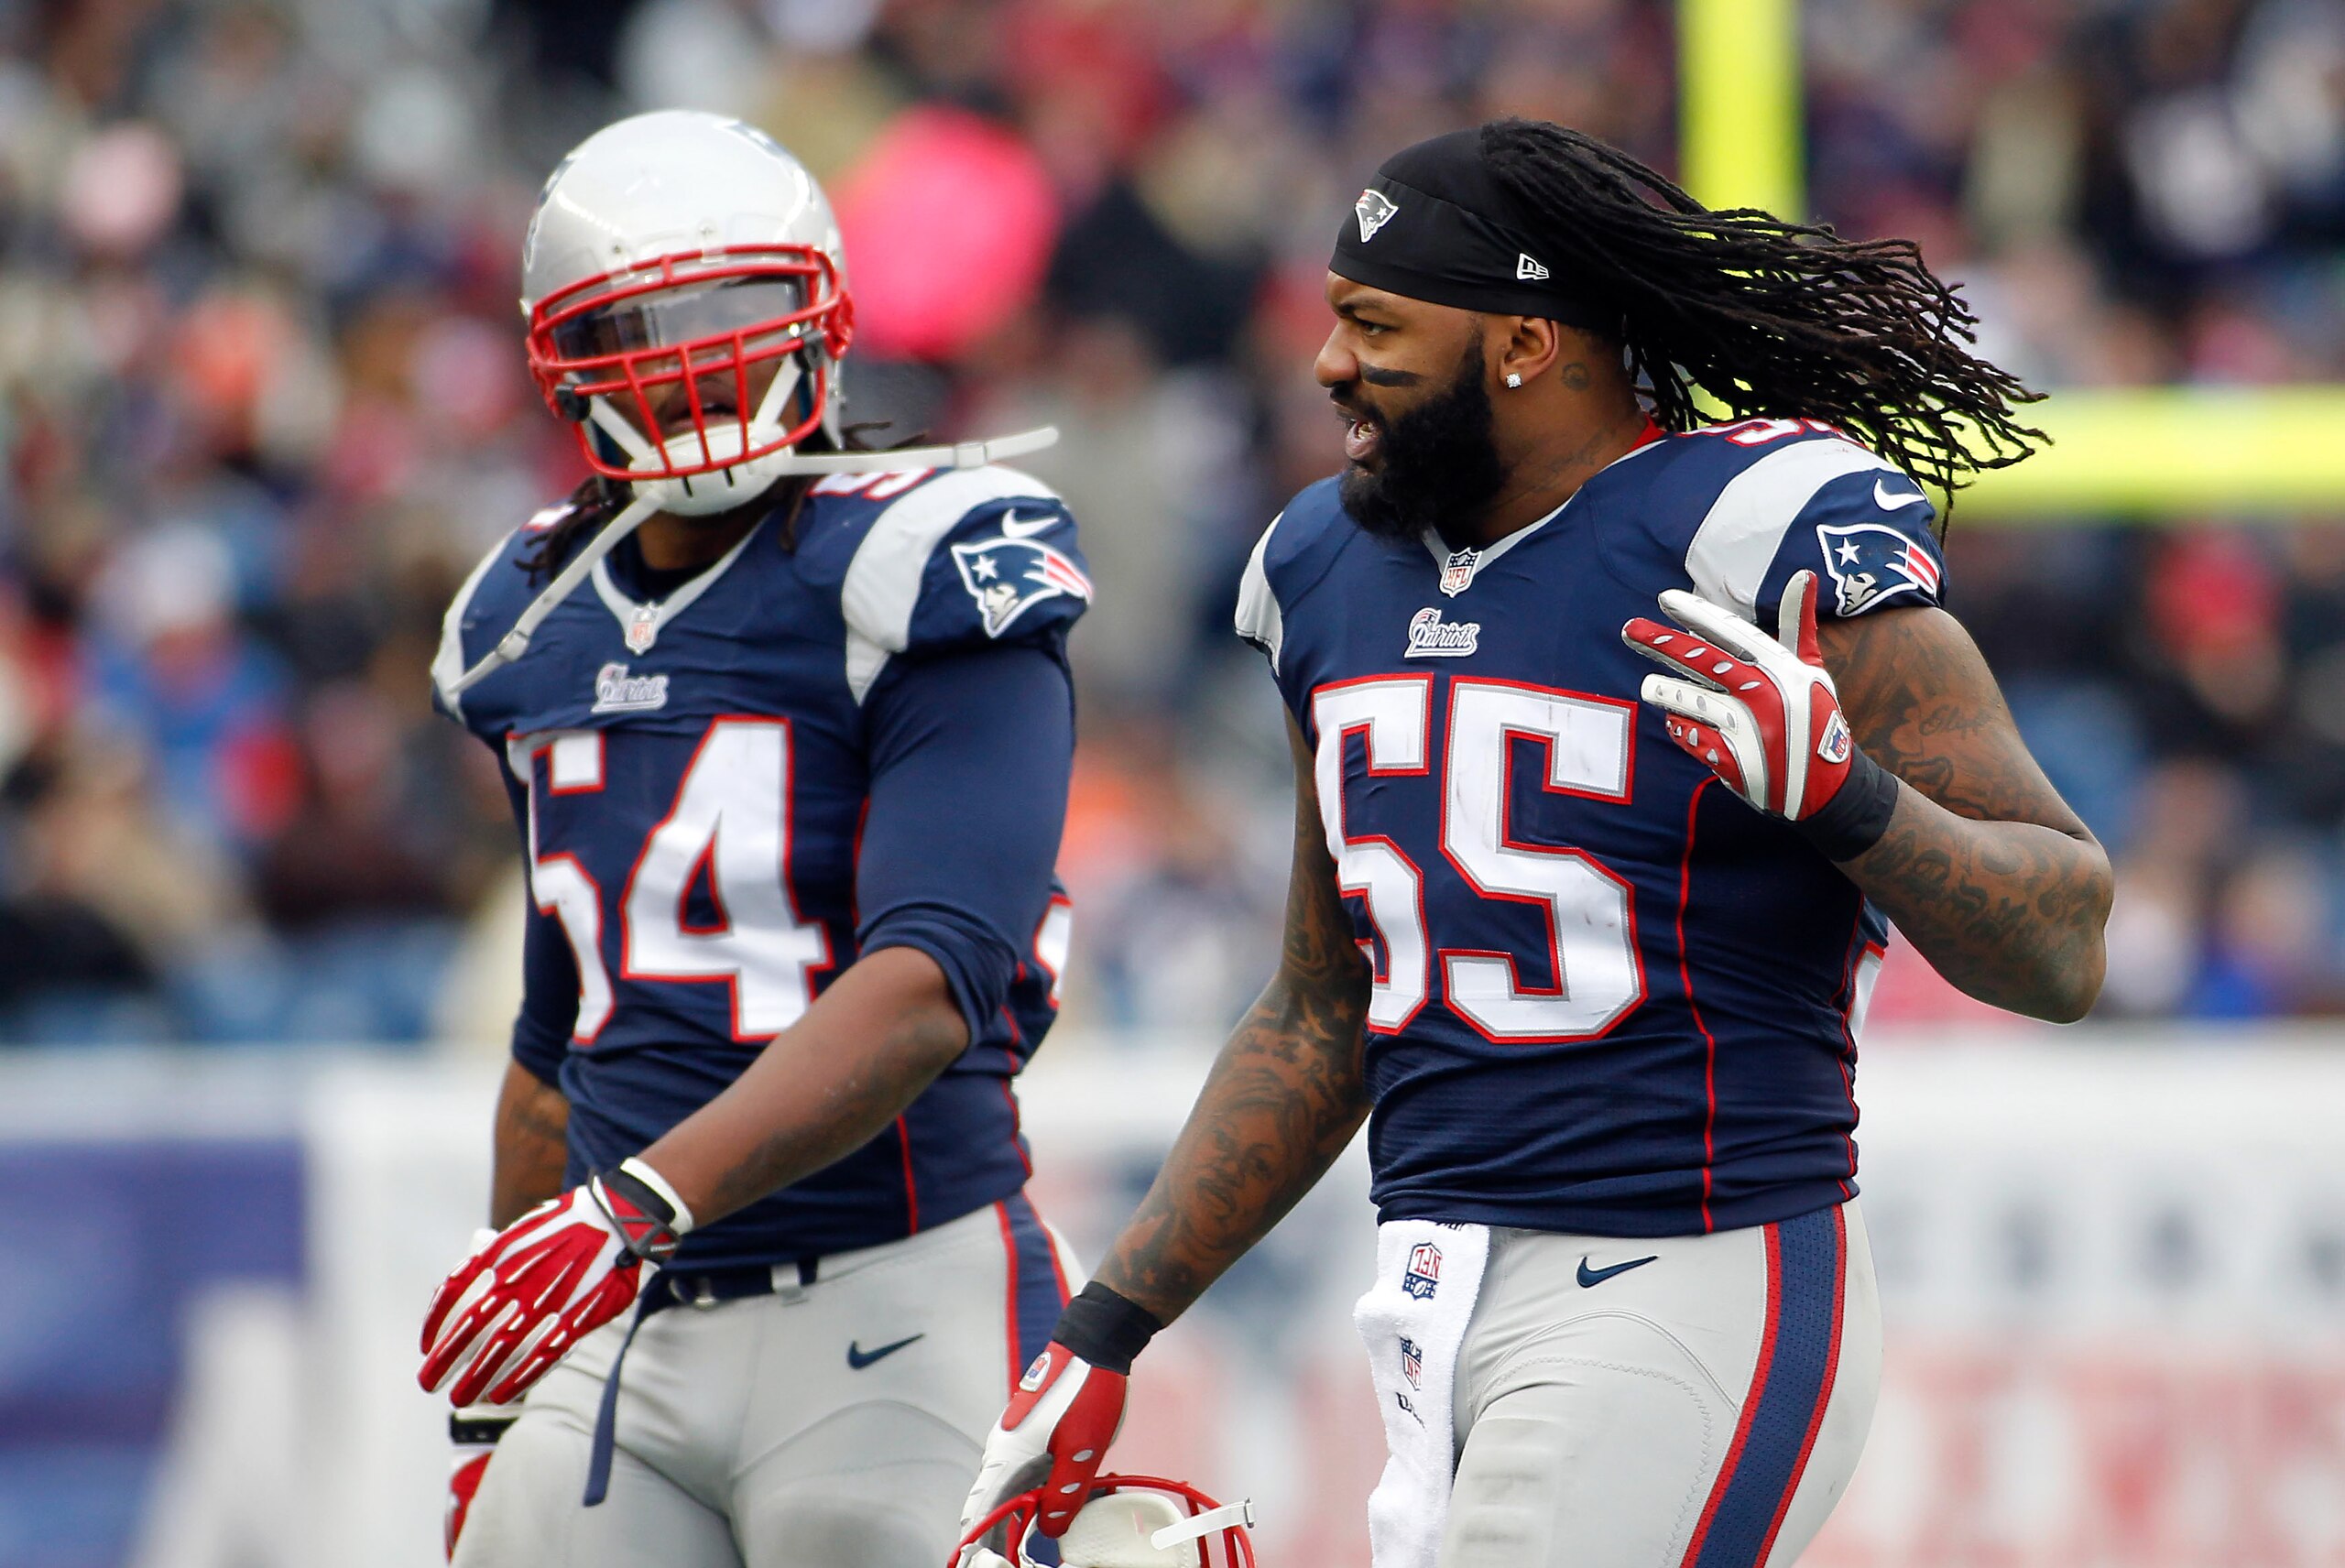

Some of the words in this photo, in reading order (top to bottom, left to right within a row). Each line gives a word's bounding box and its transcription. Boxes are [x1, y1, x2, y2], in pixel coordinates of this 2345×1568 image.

[1445, 567, 1468, 588] NFL
[1408, 620, 1480, 656] Patriots
[1311, 672, 1648, 1044] 55
[506, 714, 835, 1045] 54
[1413, 1247, 1443, 1280] NFL
